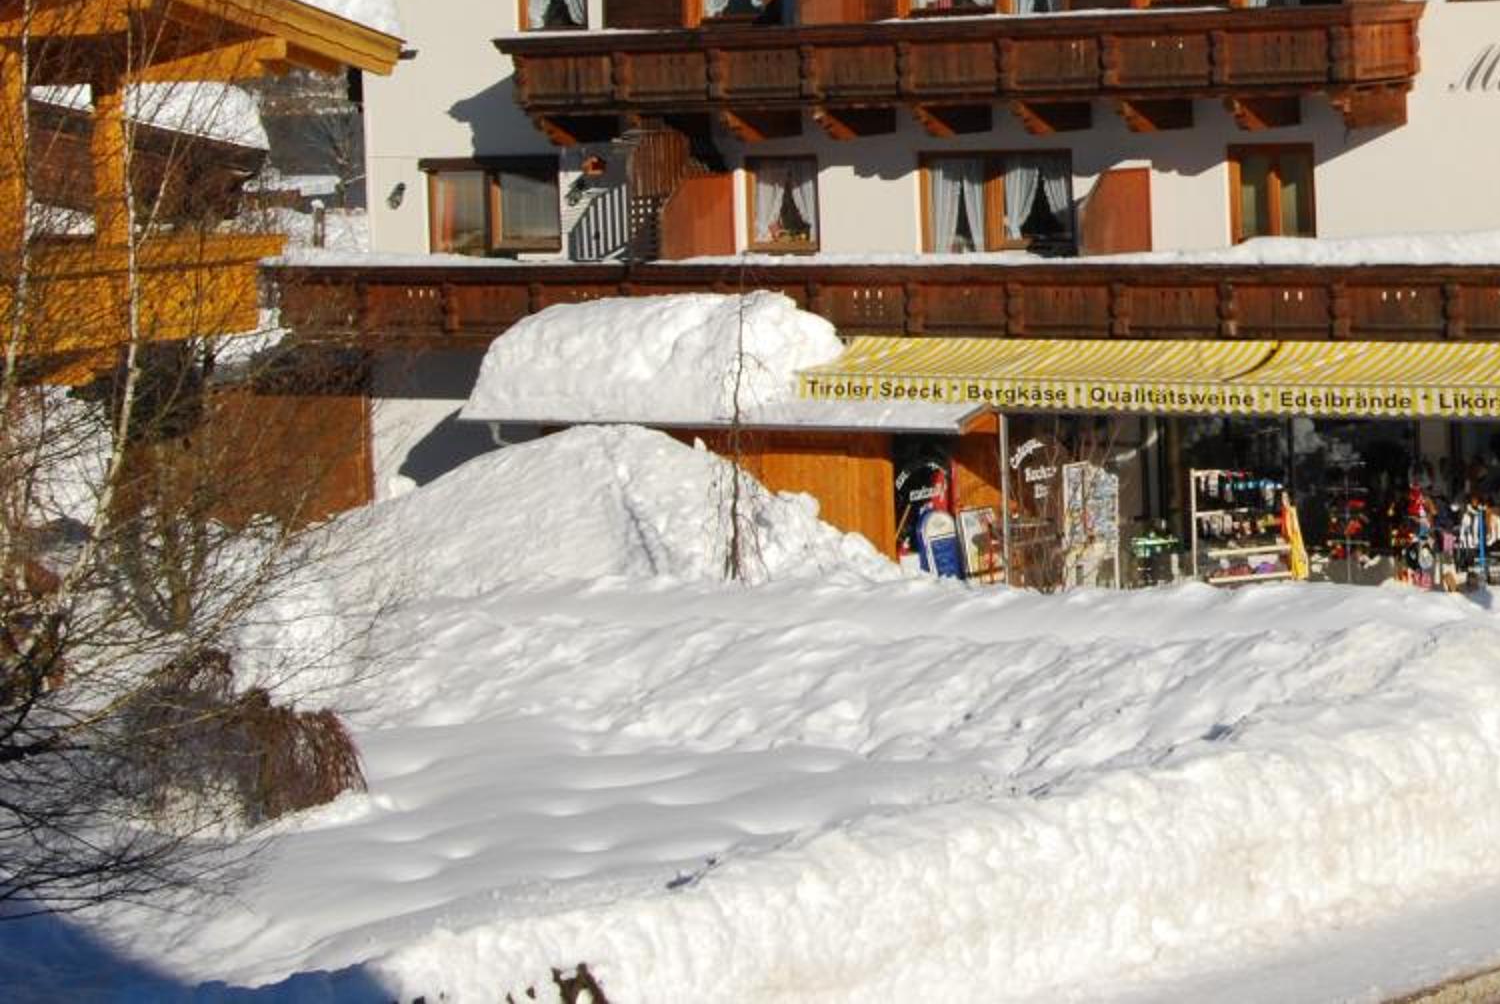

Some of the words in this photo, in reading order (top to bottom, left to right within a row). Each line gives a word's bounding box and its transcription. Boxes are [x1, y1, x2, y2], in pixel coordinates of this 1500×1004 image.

[807, 379, 873, 397] Tiroler
[880, 381, 943, 400] Speck
[968, 384, 1067, 405] Bergkäse
[1090, 386, 1255, 407] Qualitätsweine
[1280, 390, 1413, 409] Edelbrände
